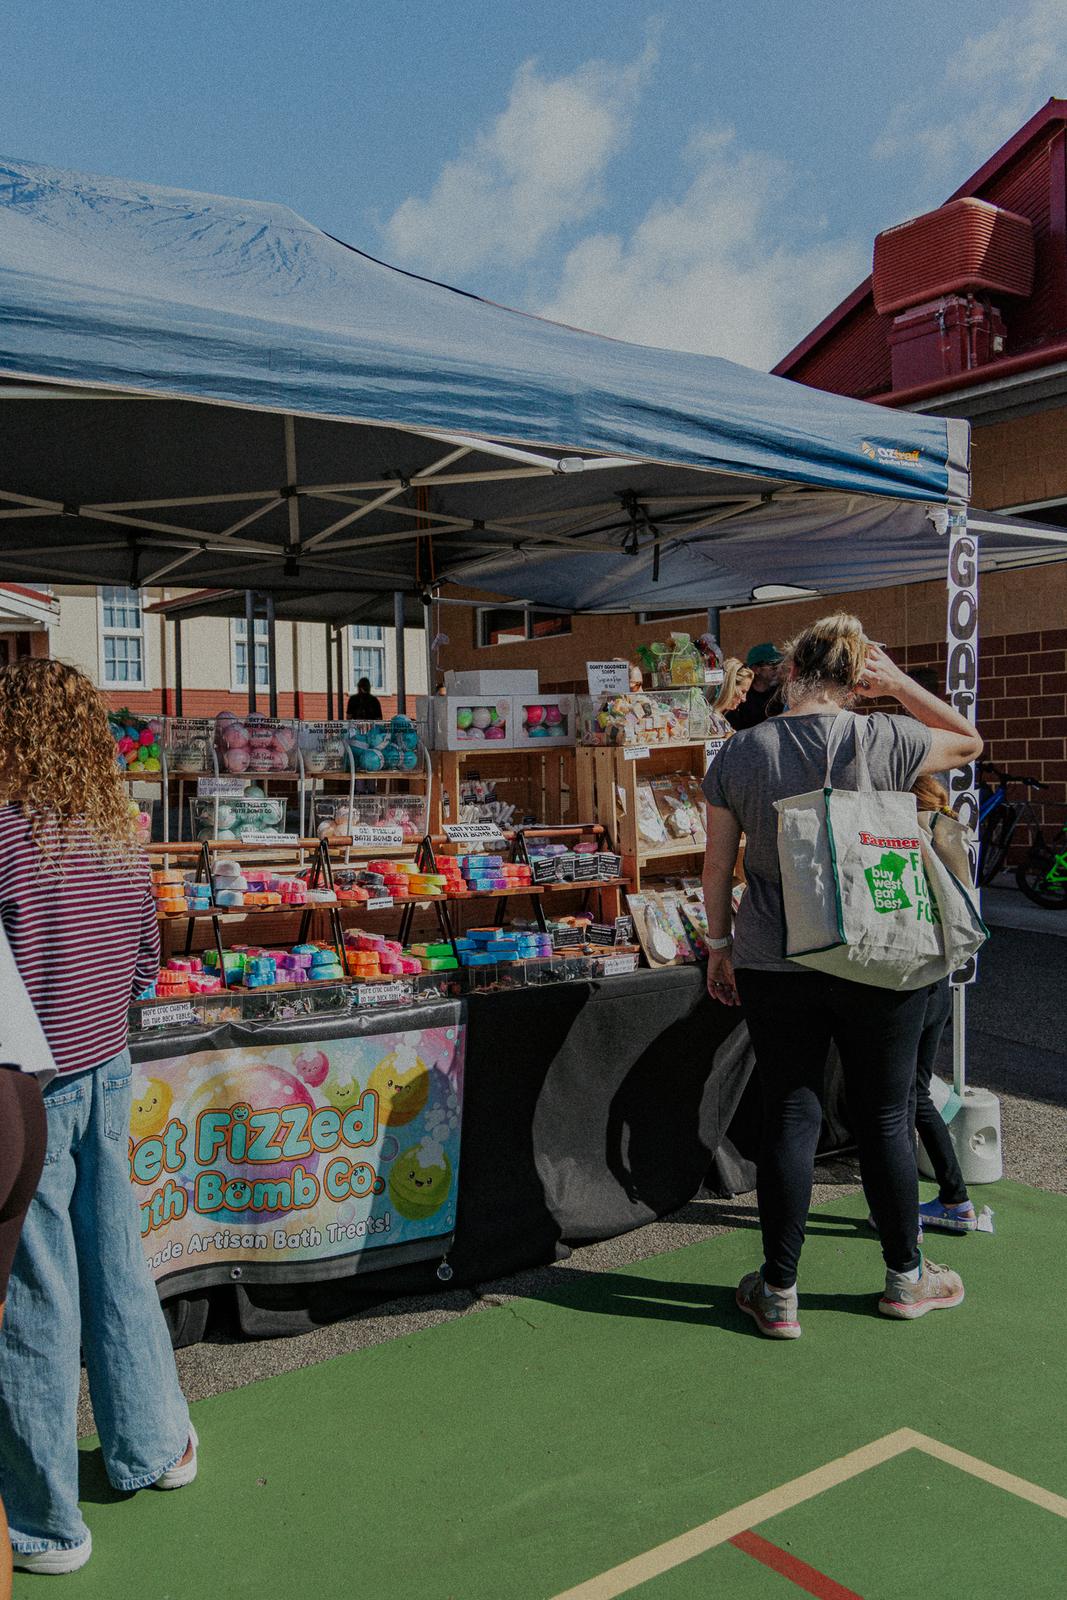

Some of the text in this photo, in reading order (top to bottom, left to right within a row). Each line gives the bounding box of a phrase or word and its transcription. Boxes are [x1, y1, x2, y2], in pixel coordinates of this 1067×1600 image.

[354, 834, 372, 842] BATH
[859, 831, 920, 849] Farmer
[872, 866, 894, 881] buy
[873, 879, 901, 890] west
[874, 888, 896, 898] eat
[876, 896, 902, 908] best
[169, 1004, 189, 1012] CHARMS
[175, 1012, 191, 1020] TABLE
[128, 1118, 187, 1185] et
[194, 1164, 320, 1213] Bomb
[323, 1156, 386, 1202] Co.
[188, 1229, 268, 1254] Artisan
[274, 1227, 322, 1250] Bath
[326, 1212, 391, 1242] Treats!
